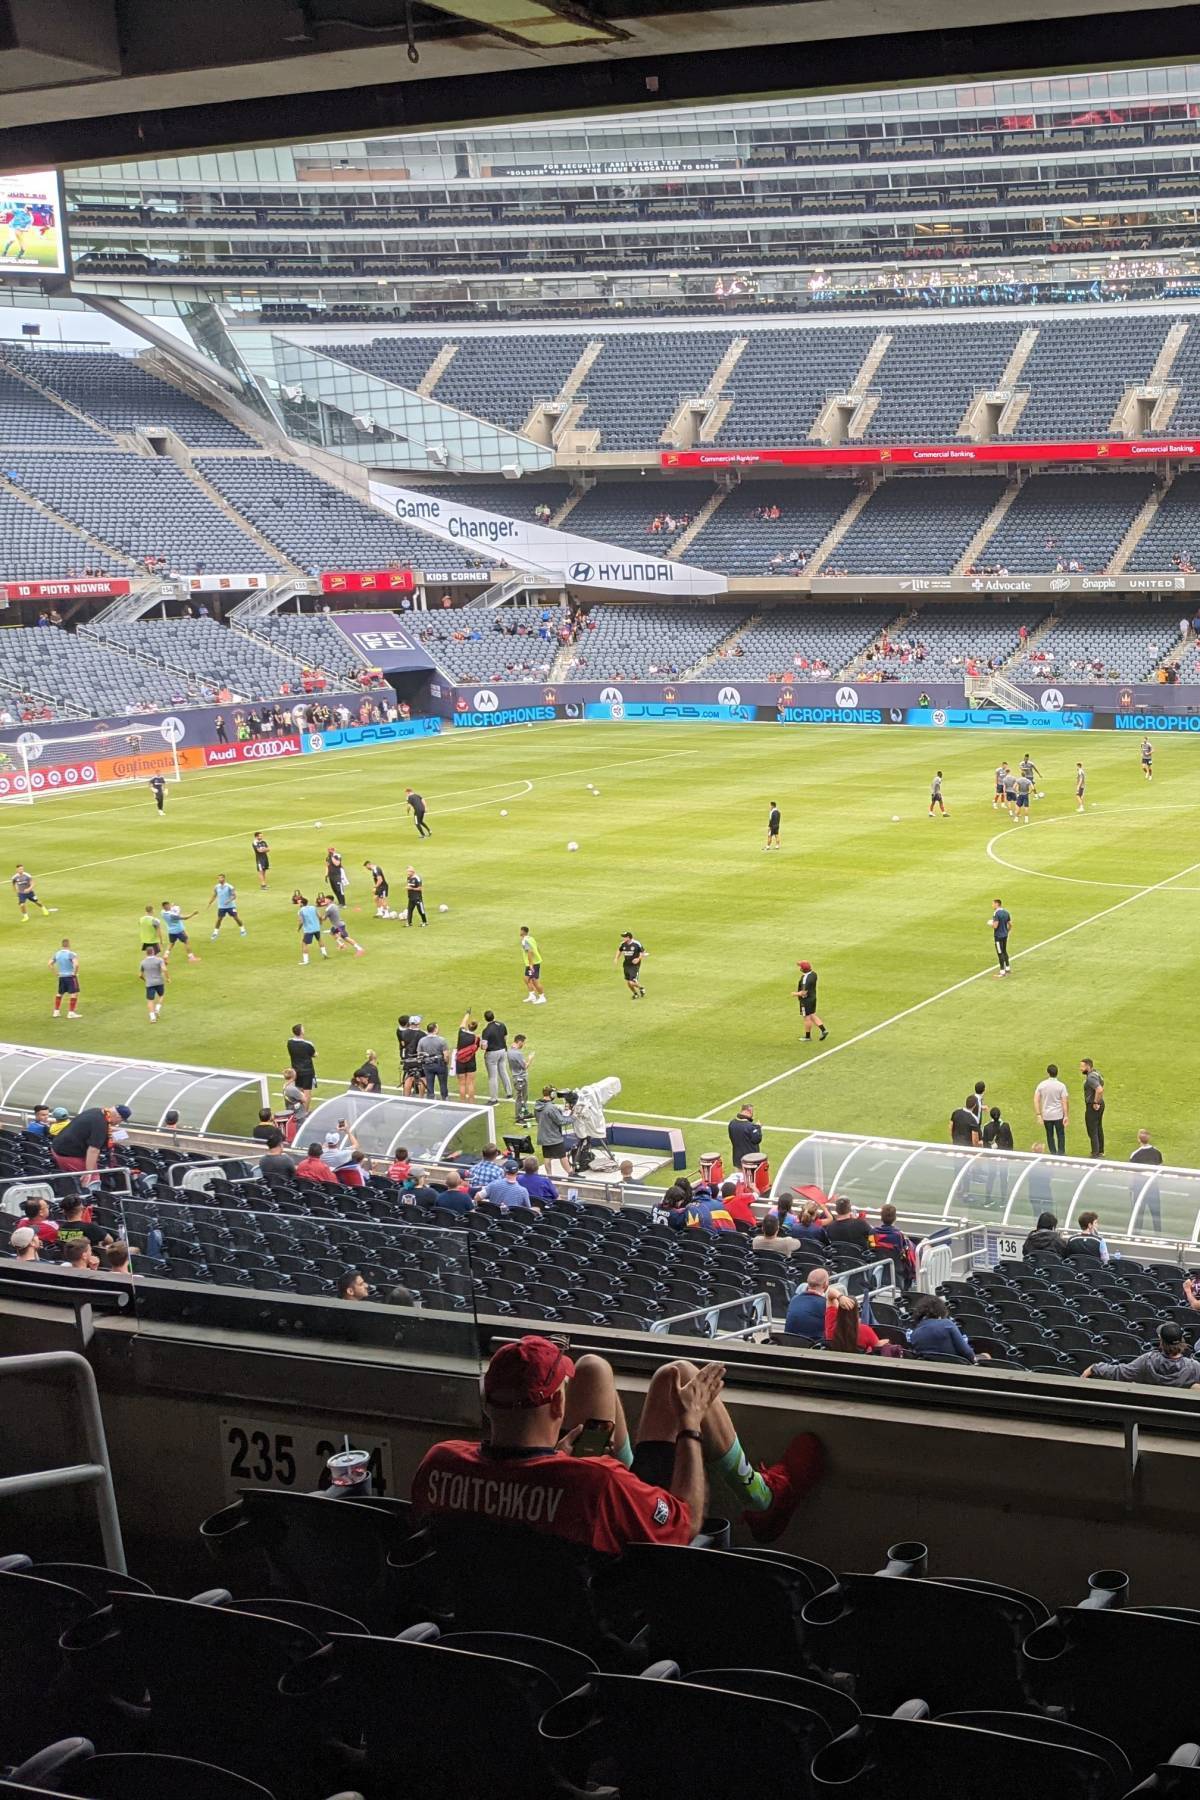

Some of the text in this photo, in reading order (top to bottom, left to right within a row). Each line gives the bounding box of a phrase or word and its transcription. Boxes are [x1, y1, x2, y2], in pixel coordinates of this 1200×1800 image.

[913, 450, 949, 459] Commercial
[1131, 445, 1168, 454] Commercial
[395, 499, 440, 518] Game
[448, 517, 519, 541] Changer.
[426, 572, 488, 582] KIDS CORNER
[599, 564, 673, 582] HYUNDAI
[19, 582, 111, 596] 10 PIOTR NOWAK
[986, 580, 1031, 590] Advocate
[1082, 578, 1116, 590] Snapple
[1130, 580, 1172, 588] UNITED
[454, 706, 556, 727] MICROPHONES
[777, 708, 881, 724] MICROPHONES
[208, 749, 236, 761] Audi
[999, 1240, 1017, 1254] 136
[228, 1428, 297, 1486] 235
[428, 1470, 564, 1522] STOITCHKOV
